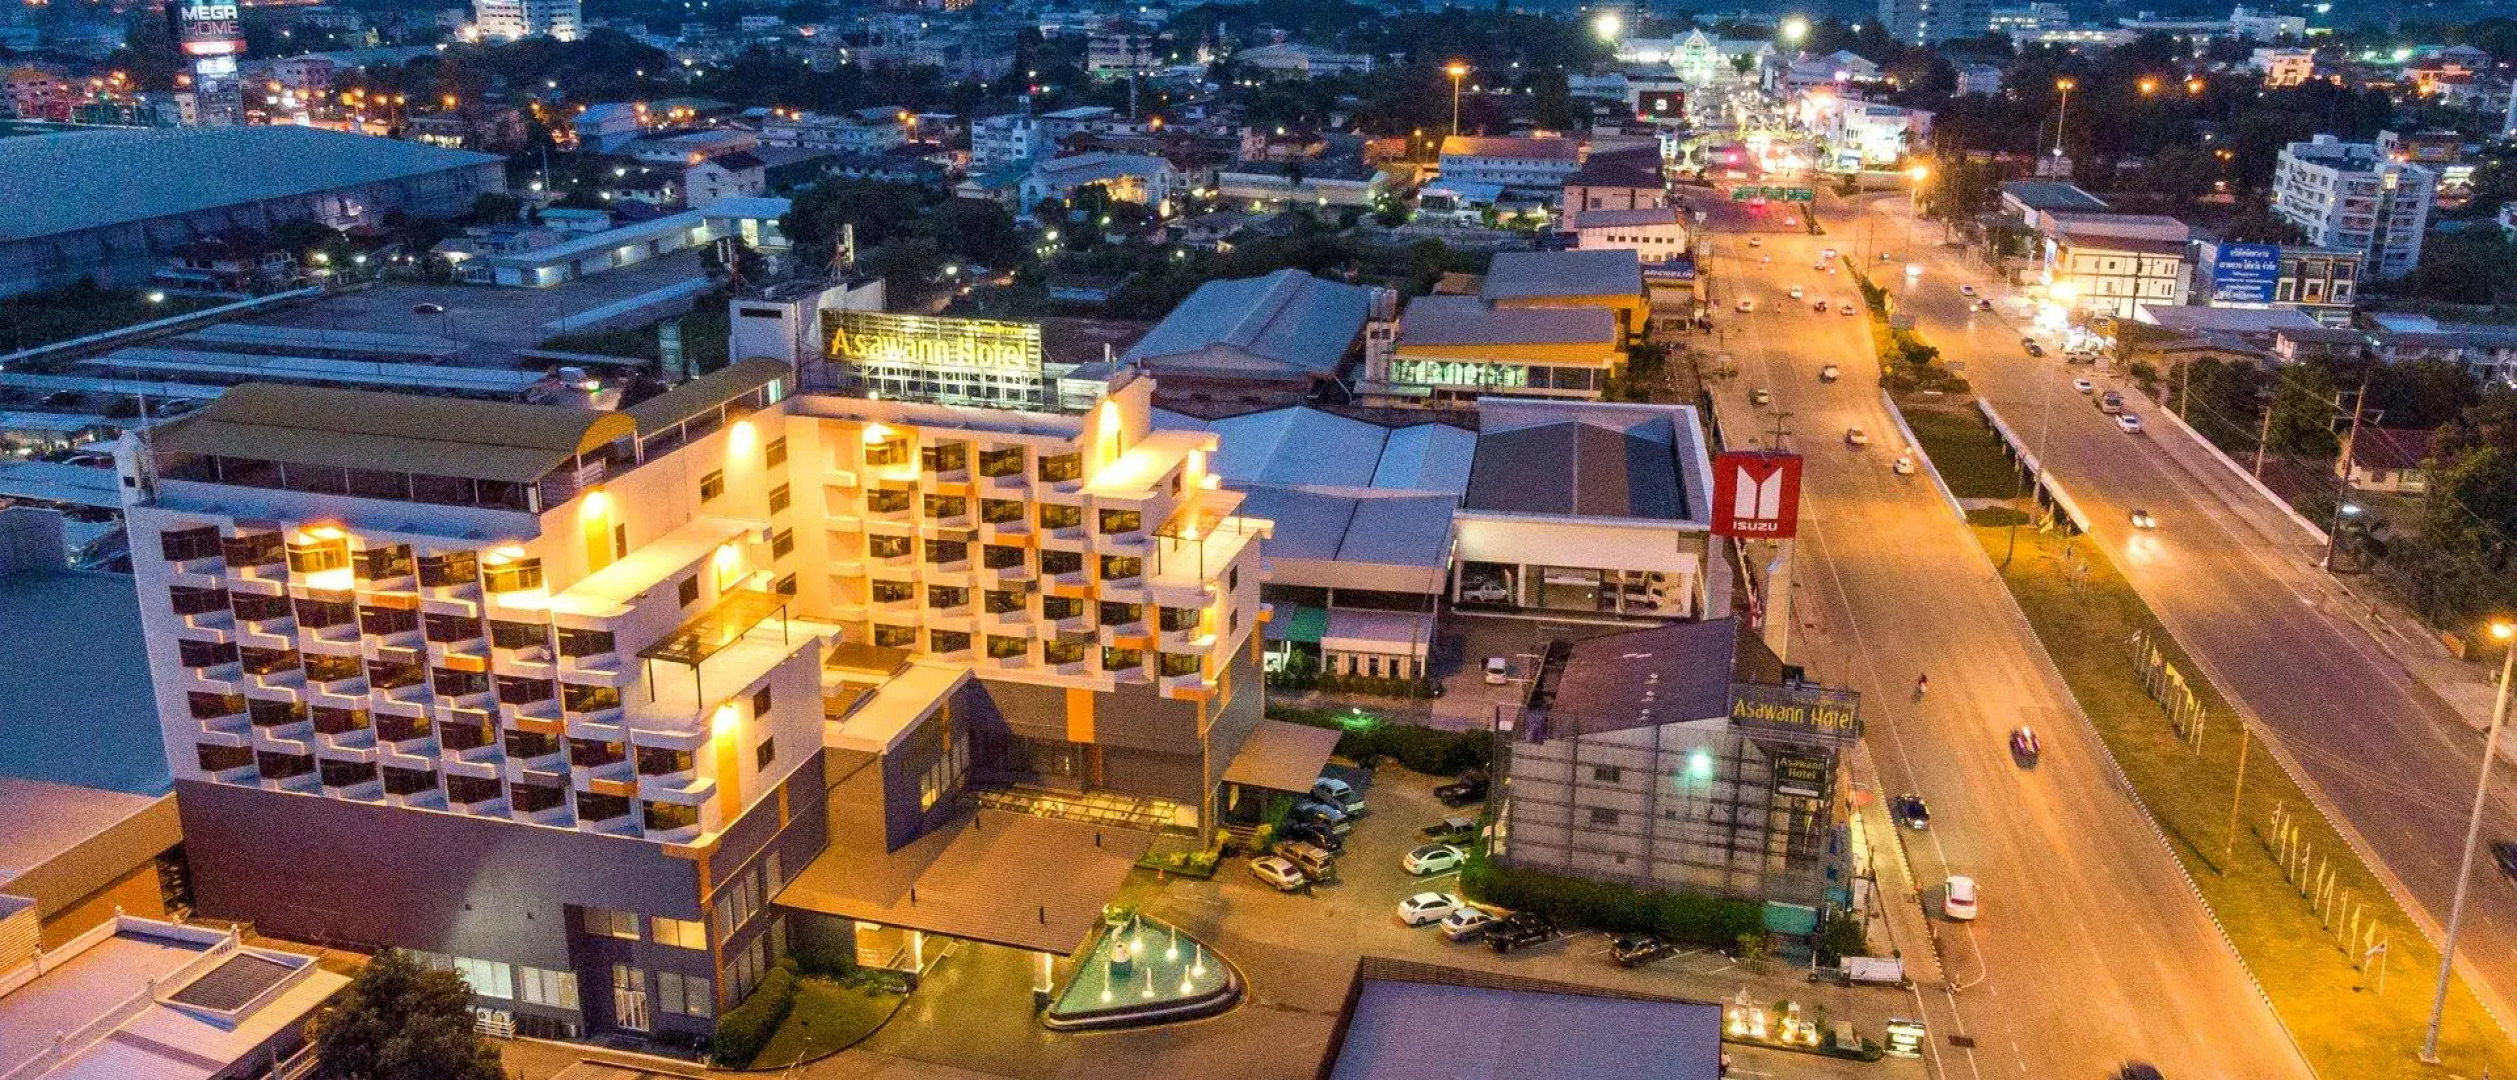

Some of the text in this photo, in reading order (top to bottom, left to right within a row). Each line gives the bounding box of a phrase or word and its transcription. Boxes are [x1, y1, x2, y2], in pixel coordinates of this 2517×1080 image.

[181, 5, 238, 20] MEGA
[184, 21, 240, 35] HOME
[1644, 270, 1694, 279] MICHELIN
[831, 327, 1029, 369] Asawann Hotel
[1733, 521, 1777, 531] ISUZU
[1734, 699, 1854, 730] Asawann Hotel
[1780, 758, 1825, 770] Asawann
[1788, 767, 1817, 780] Hotel
